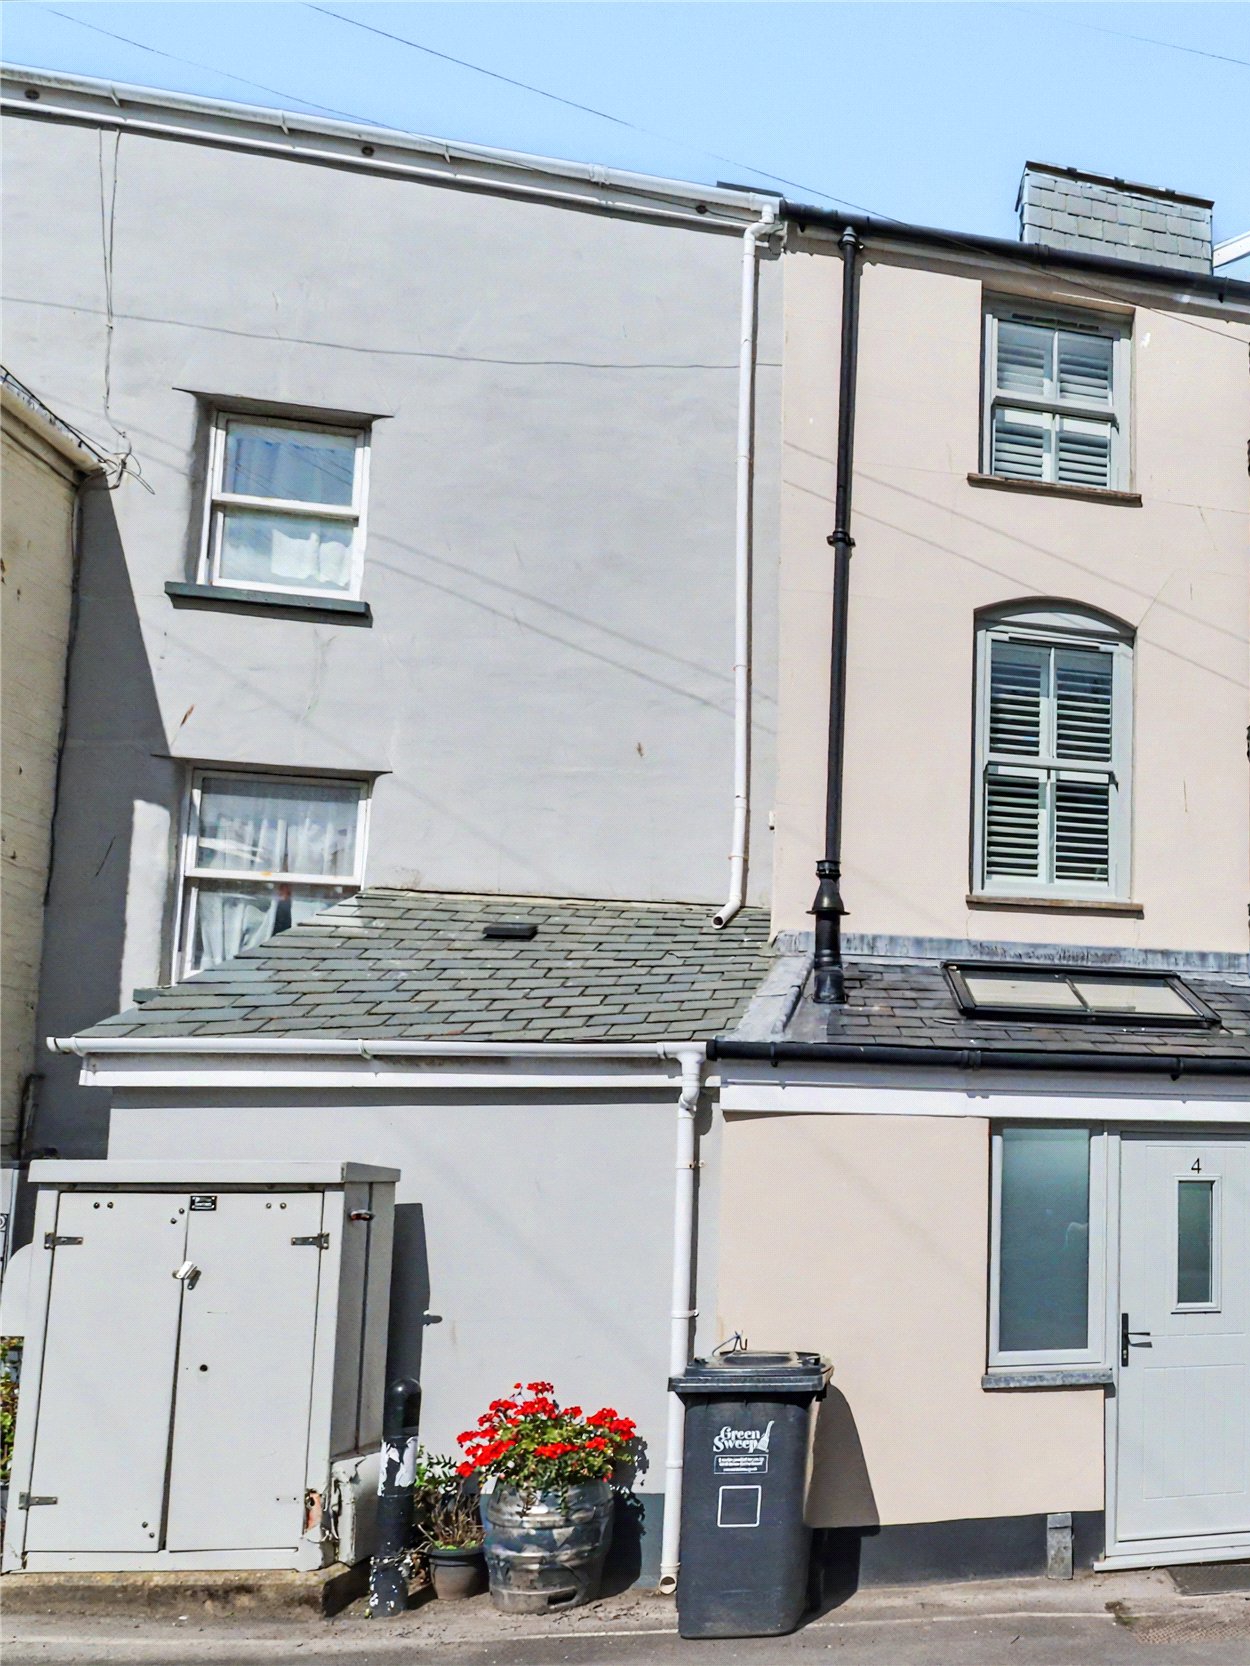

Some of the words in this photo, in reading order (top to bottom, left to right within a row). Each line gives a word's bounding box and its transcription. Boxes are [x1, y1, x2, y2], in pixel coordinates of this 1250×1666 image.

[1191, 1157, 1202, 1174] 4
[720, 1426, 761, 1440] Green
[713, 1435, 759, 1453] Sweep
